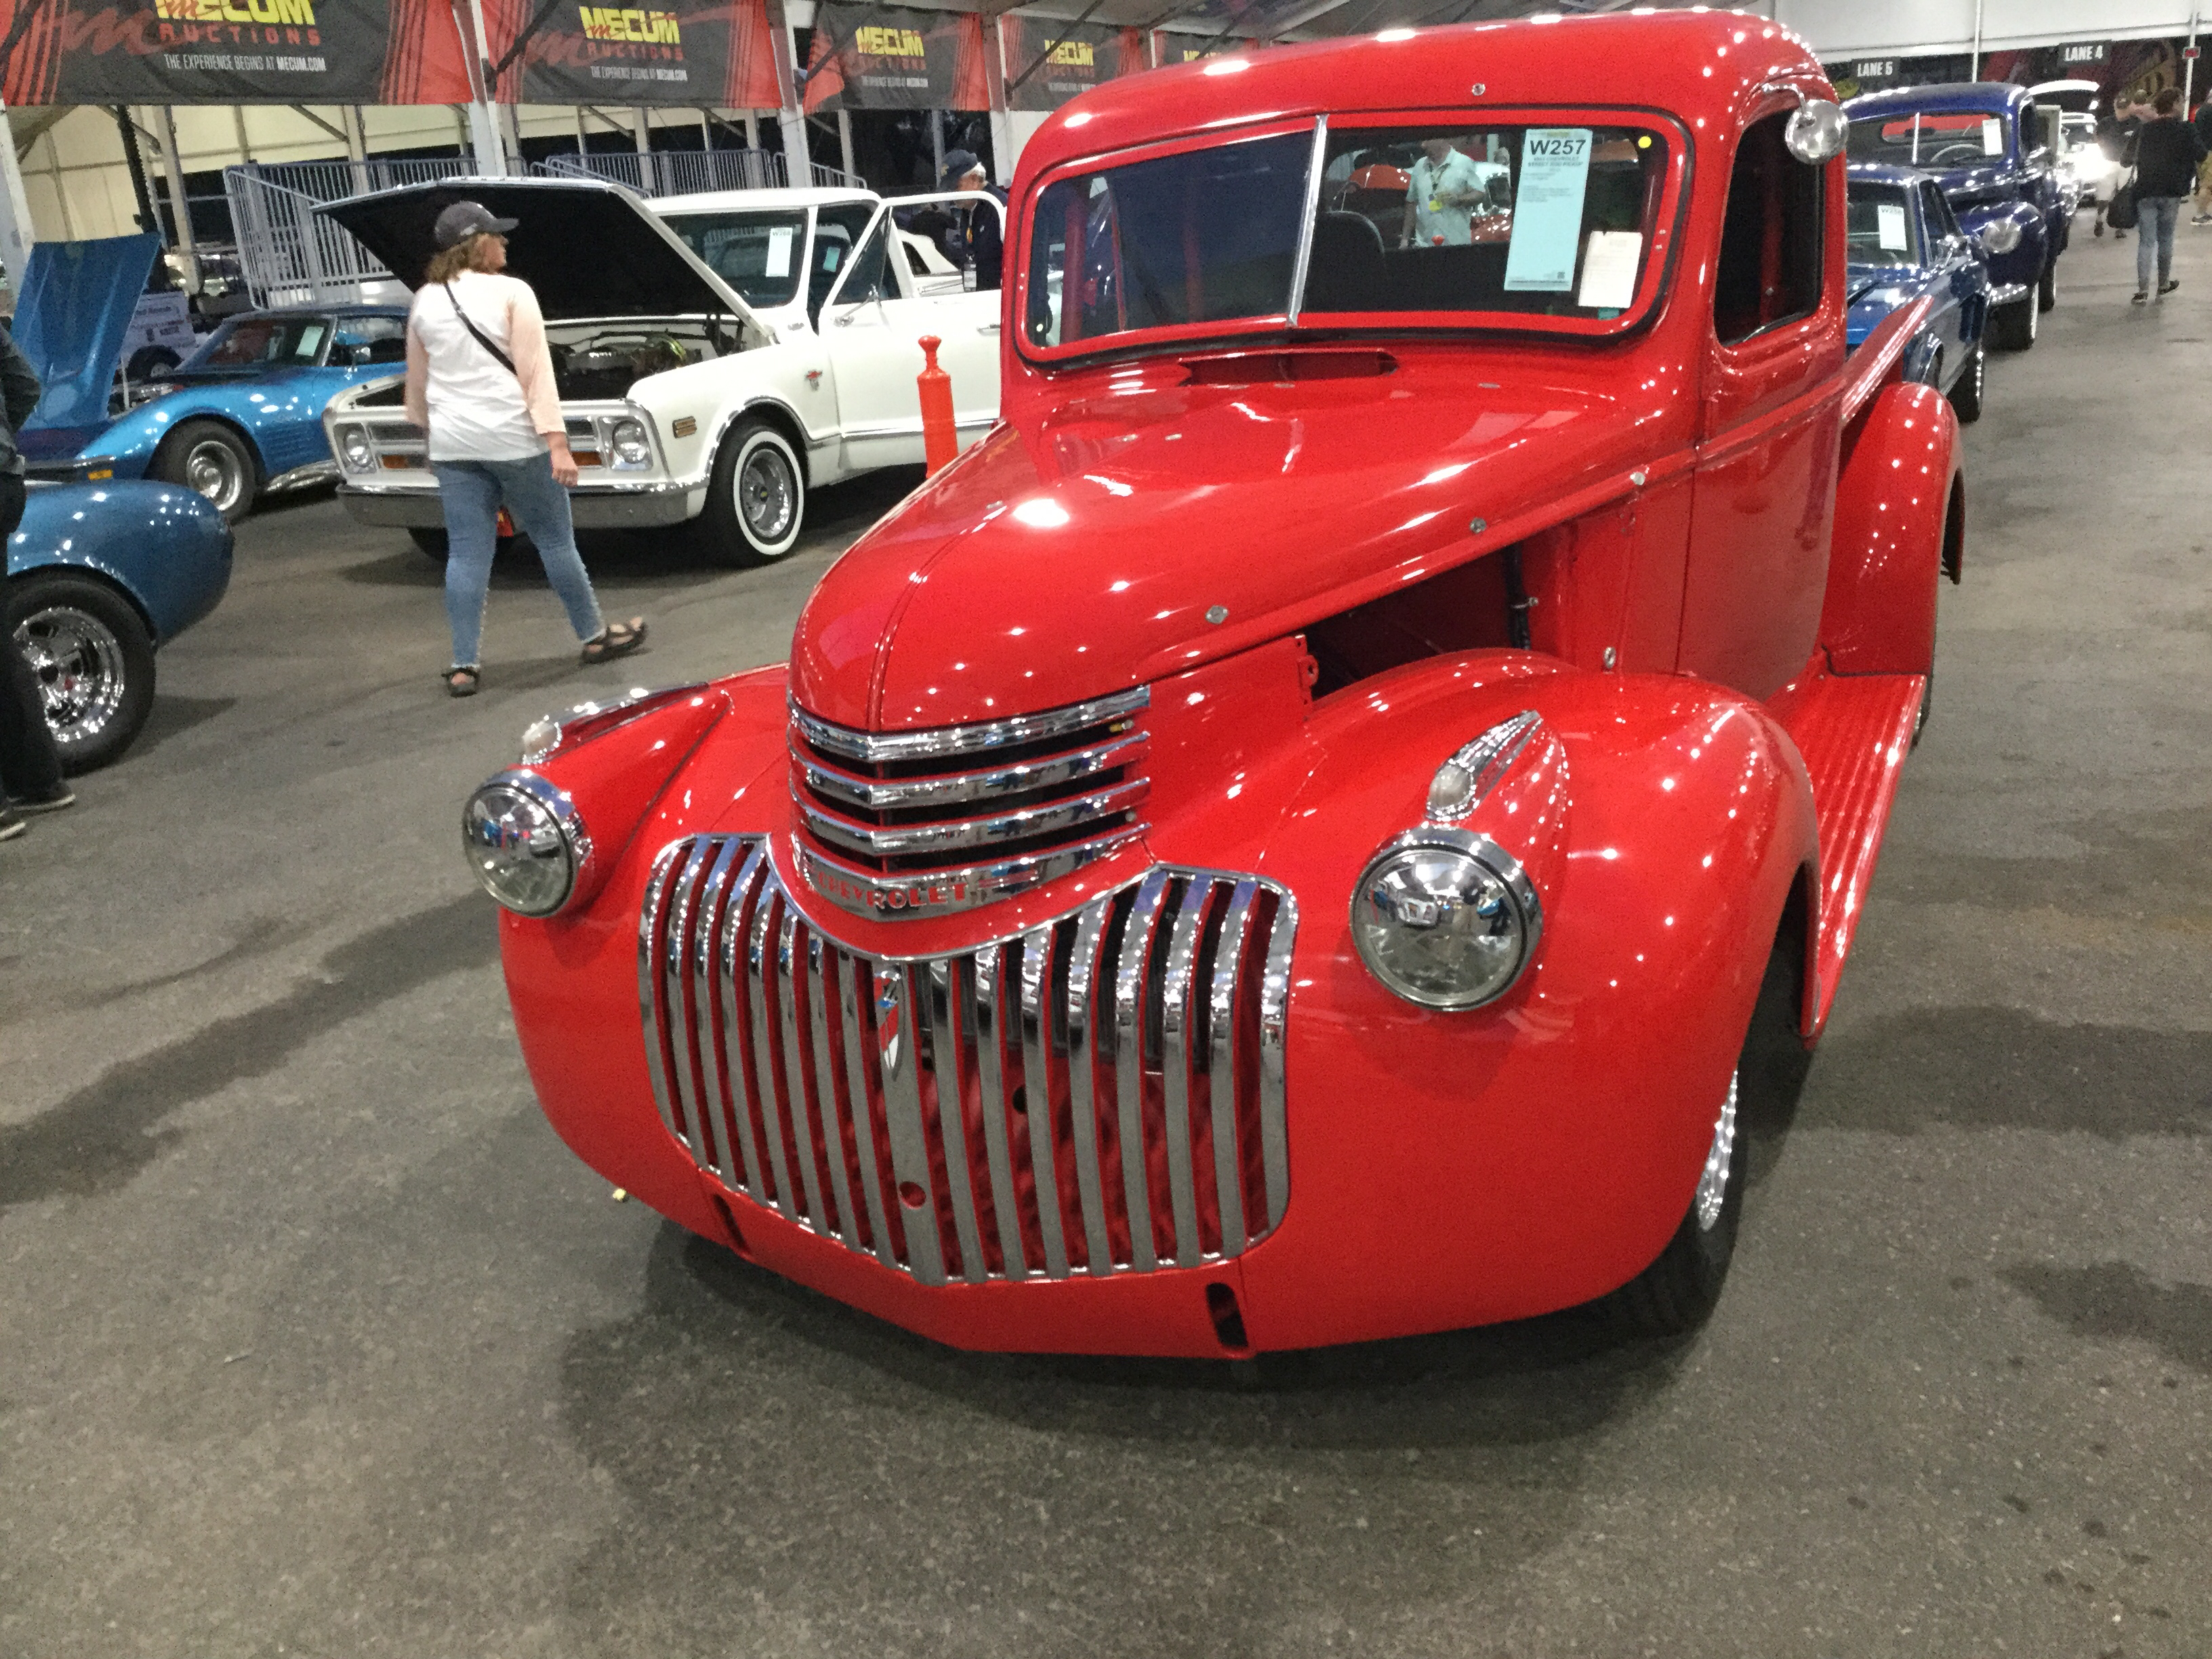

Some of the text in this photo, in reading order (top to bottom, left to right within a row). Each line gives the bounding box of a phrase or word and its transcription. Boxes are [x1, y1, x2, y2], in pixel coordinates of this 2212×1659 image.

[158, 23, 321, 46] AUCTIONS
[579, 6, 680, 44] MECUM
[855, 26, 924, 56] MECUM
[1044, 39, 1094, 66] MECUM
[164, 54, 327, 72] THE EXPERIENCE BEGINS AT MECUM.COM
[2064, 45, 2104, 62] LANE 4
[1857, 62, 1883, 77] LANE
[1530, 139, 1586, 155] W257
[818, 871, 968, 909] CHEVROLET
